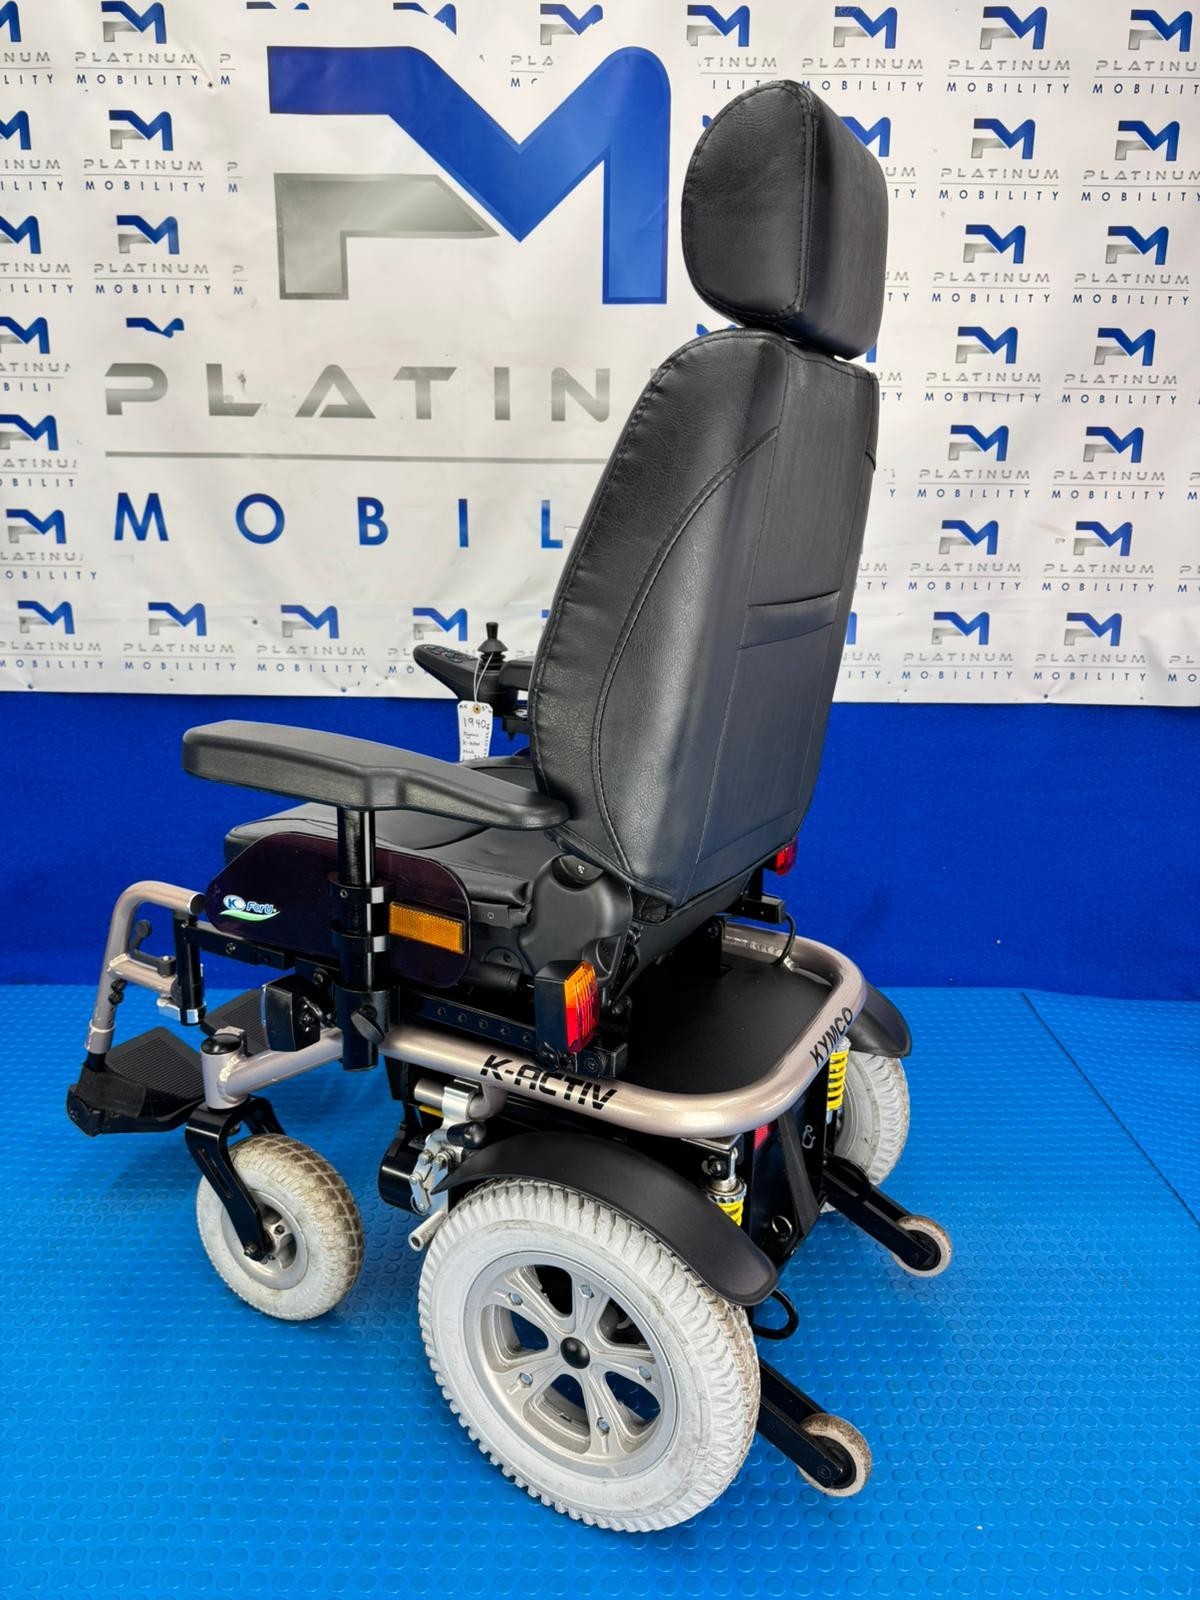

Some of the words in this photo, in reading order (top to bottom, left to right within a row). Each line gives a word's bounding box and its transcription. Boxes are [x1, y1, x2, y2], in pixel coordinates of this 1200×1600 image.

[75, 51, 196, 64] PLATINUM
[703, 56, 777, 68] TINUM
[801, 57, 923, 70] PLATINUM
[948, 59, 1070, 71] PLATINUM
[1096, 59, 1198, 72] PLATINU
[4, 74, 53, 85] LITY
[76, 74, 198, 86] MOBILITY
[946, 82, 1070, 94] MOBILITY
[1092, 83, 1200, 95] MOBILIT
[4, 159, 61, 170] INUM
[83, 158, 203, 172] PLATINUM
[940, 167, 1059, 180] PLATINUM
[0, 180, 64, 191] ILITY
[85, 180, 206, 193] MOBILITY
[938, 188, 1059, 201] MOBILITY
[0, 262, 71, 274] TINUM
[93, 262, 209, 275] PLATINUM
[932, 271, 1050, 283] PLATINUM
[1074, 272, 1190, 285] PLATINUM
[10, 283, 74, 294] ILITY
[95, 284, 212, 296] MOBILITY
[931, 292, 1051, 304] MOBILITY
[1072, 293, 1190, 306] MOBILITY
[925, 371, 1042, 383] PLATINUM
[1063, 373, 1178, 386] PLATINUM
[104, 362, 612, 422] PLATIN
[924, 391, 1041, 403] MOBILITY
[1061, 394, 1178, 405] MOBILITY
[2, 458, 77, 469] ATINU
[918, 468, 1031, 480] PLATINUM
[1052, 470, 1166, 482] PLATINUM
[0, 477, 75, 488] BILIT
[917, 487, 1031, 499] MOBILITY
[1051, 489, 1166, 500] MOBILITY
[113, 492, 564, 549] MOBIL
[0, 551, 84, 562] LATINU
[909, 562, 1022, 573] PLATINUM
[1043, 563, 1156, 575] PLATINUM
[4, 570, 97, 580] OBILITY
[908, 581, 1022, 592] MOBILITY
[1042, 582, 1155, 593] MOBILITY
[123, 643, 235, 655] PLATINUM
[256, 645, 366, 656] PLATINUM
[903, 652, 1013, 663] PLATINUM
[1035, 653, 1147, 665] PLATINUM
[124, 661, 236, 672] MOBILITY
[257, 663, 368, 674] MOBILITY
[901, 670, 1013, 681] MOBILITY
[1033, 671, 1146, 682] MOBILITY
[809, 1006, 854, 1069] KYMCO
[480, 1054, 618, 1111] K-ACTIV
